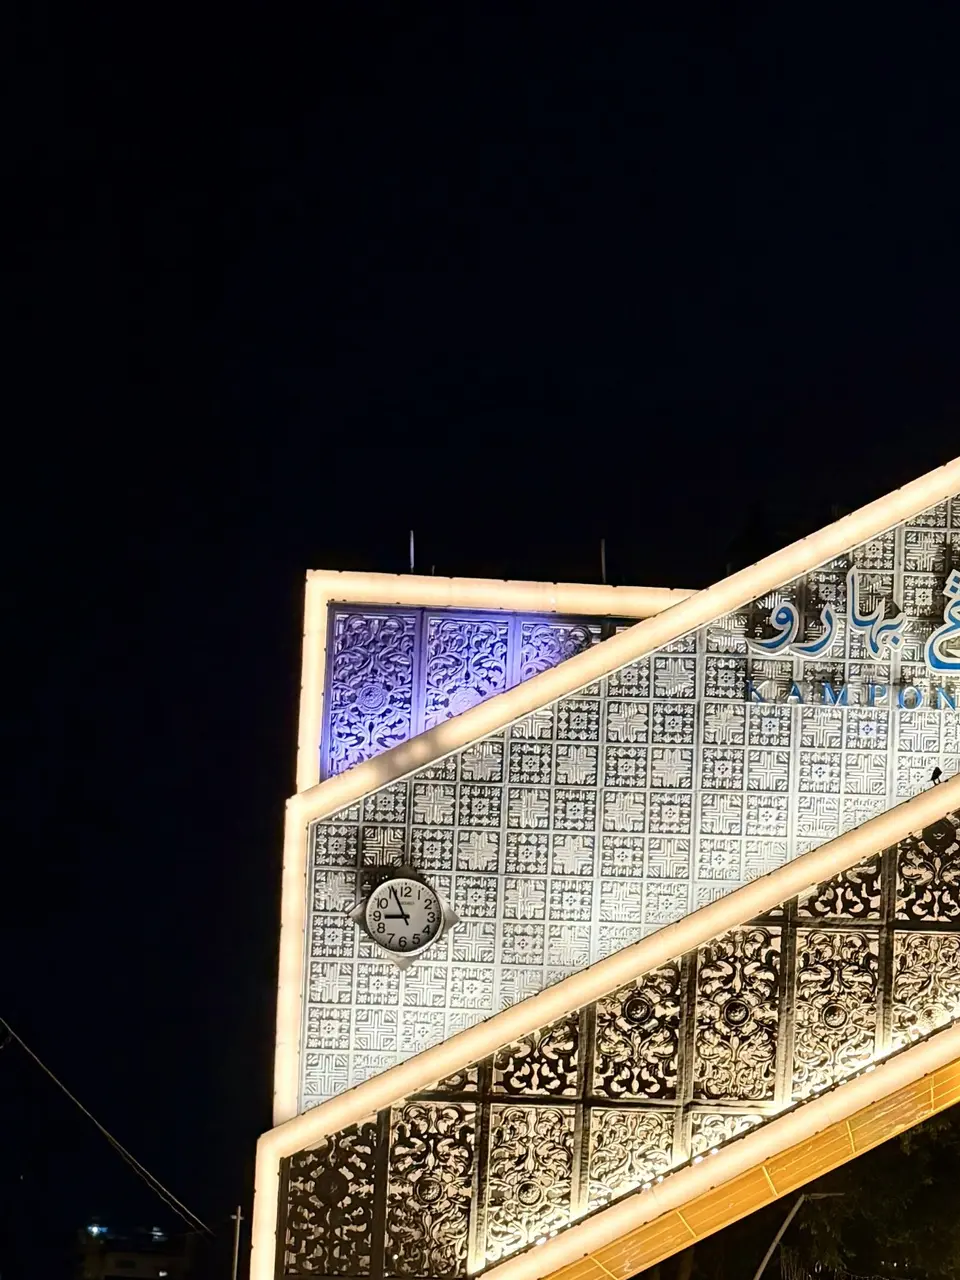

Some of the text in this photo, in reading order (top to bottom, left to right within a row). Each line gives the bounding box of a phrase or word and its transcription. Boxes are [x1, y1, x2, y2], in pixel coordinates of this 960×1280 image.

[746, 565, 907, 661] بهارو
[400, 886, 412, 898] 12
[376, 898, 388, 909] 10
[424, 899, 432, 909] 2
[372, 911, 382, 921] 9
[427, 912, 436, 923] 3
[377, 923, 386, 933] 8
[422, 925, 430, 935] 4
[387, 933, 395, 944] 7
[398, 937, 407, 948] 6
[412, 934, 421, 944] 5
